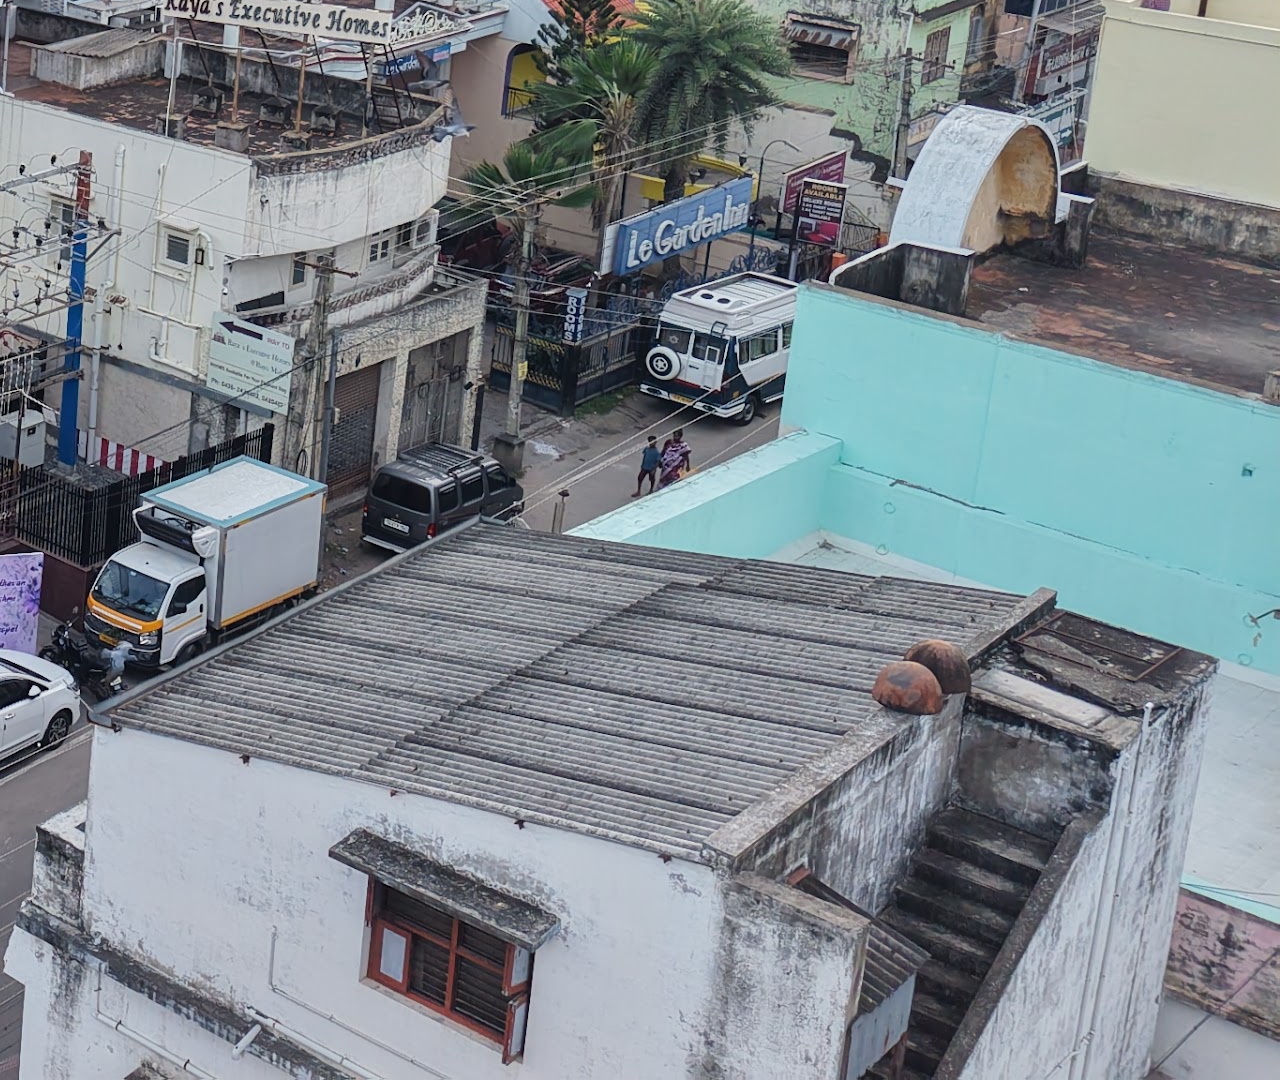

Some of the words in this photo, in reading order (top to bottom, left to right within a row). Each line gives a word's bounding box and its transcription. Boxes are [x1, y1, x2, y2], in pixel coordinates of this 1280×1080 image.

[326, 9, 390, 38] Homes
[804, 189, 844, 201] AVAILABLE
[812, 184, 838, 193] ROOMS
[627, 230, 653, 268] Le
[654, 205, 723, 255] Garden
[722, 195, 749, 231] Inn
[564, 297, 578, 341] ROOMS
